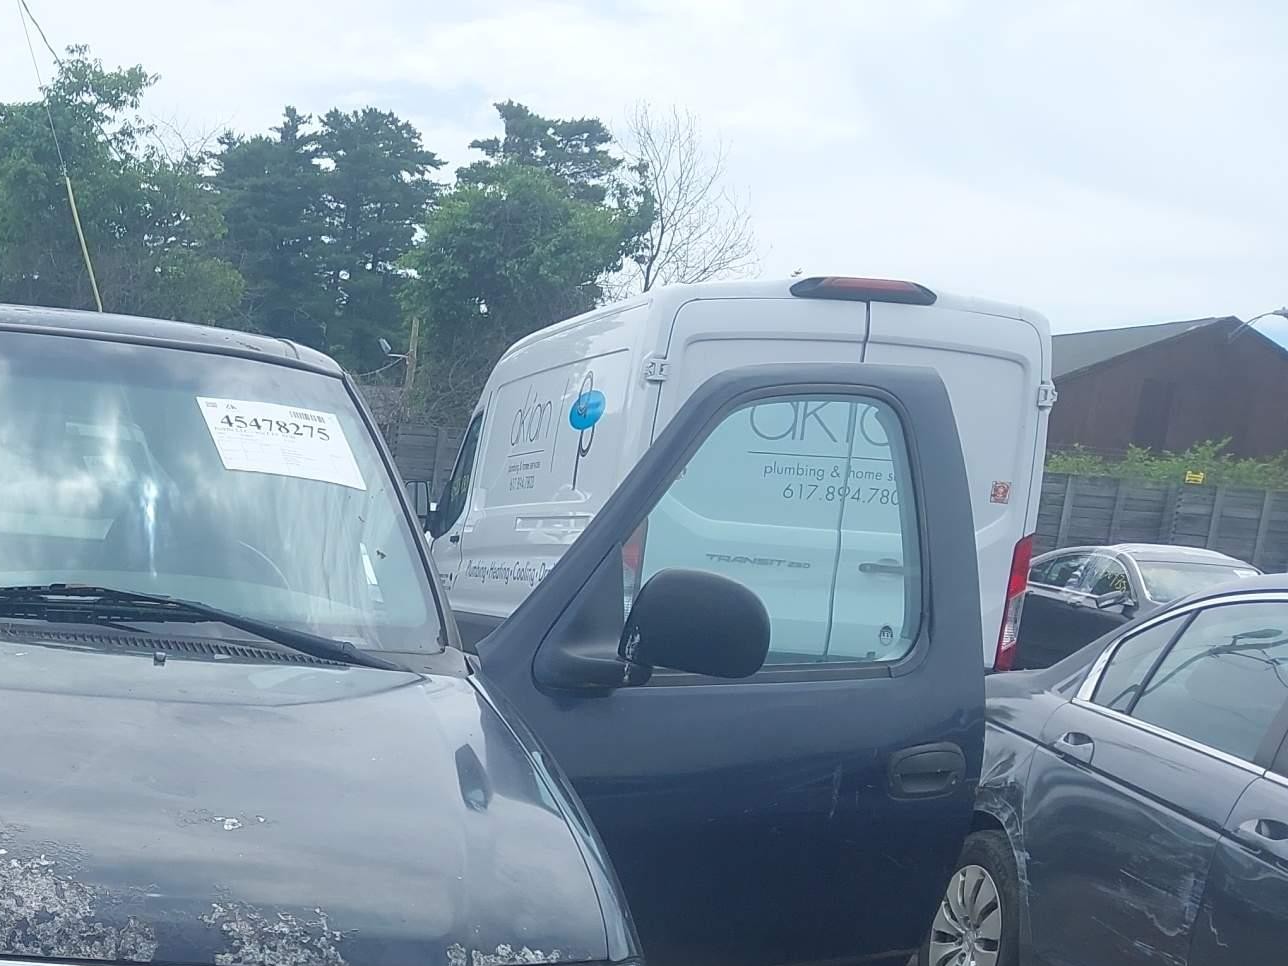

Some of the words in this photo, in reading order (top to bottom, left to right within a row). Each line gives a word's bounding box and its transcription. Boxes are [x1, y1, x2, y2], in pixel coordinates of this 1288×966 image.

[220, 414, 330, 441] 45478275
[764, 461, 825, 481] plumbing
[830, 465, 841, 478] &
[849, 465, 883, 481] home
[706, 553, 787, 567] TRANSIT
[513, 561, 536, 587] Cooling
